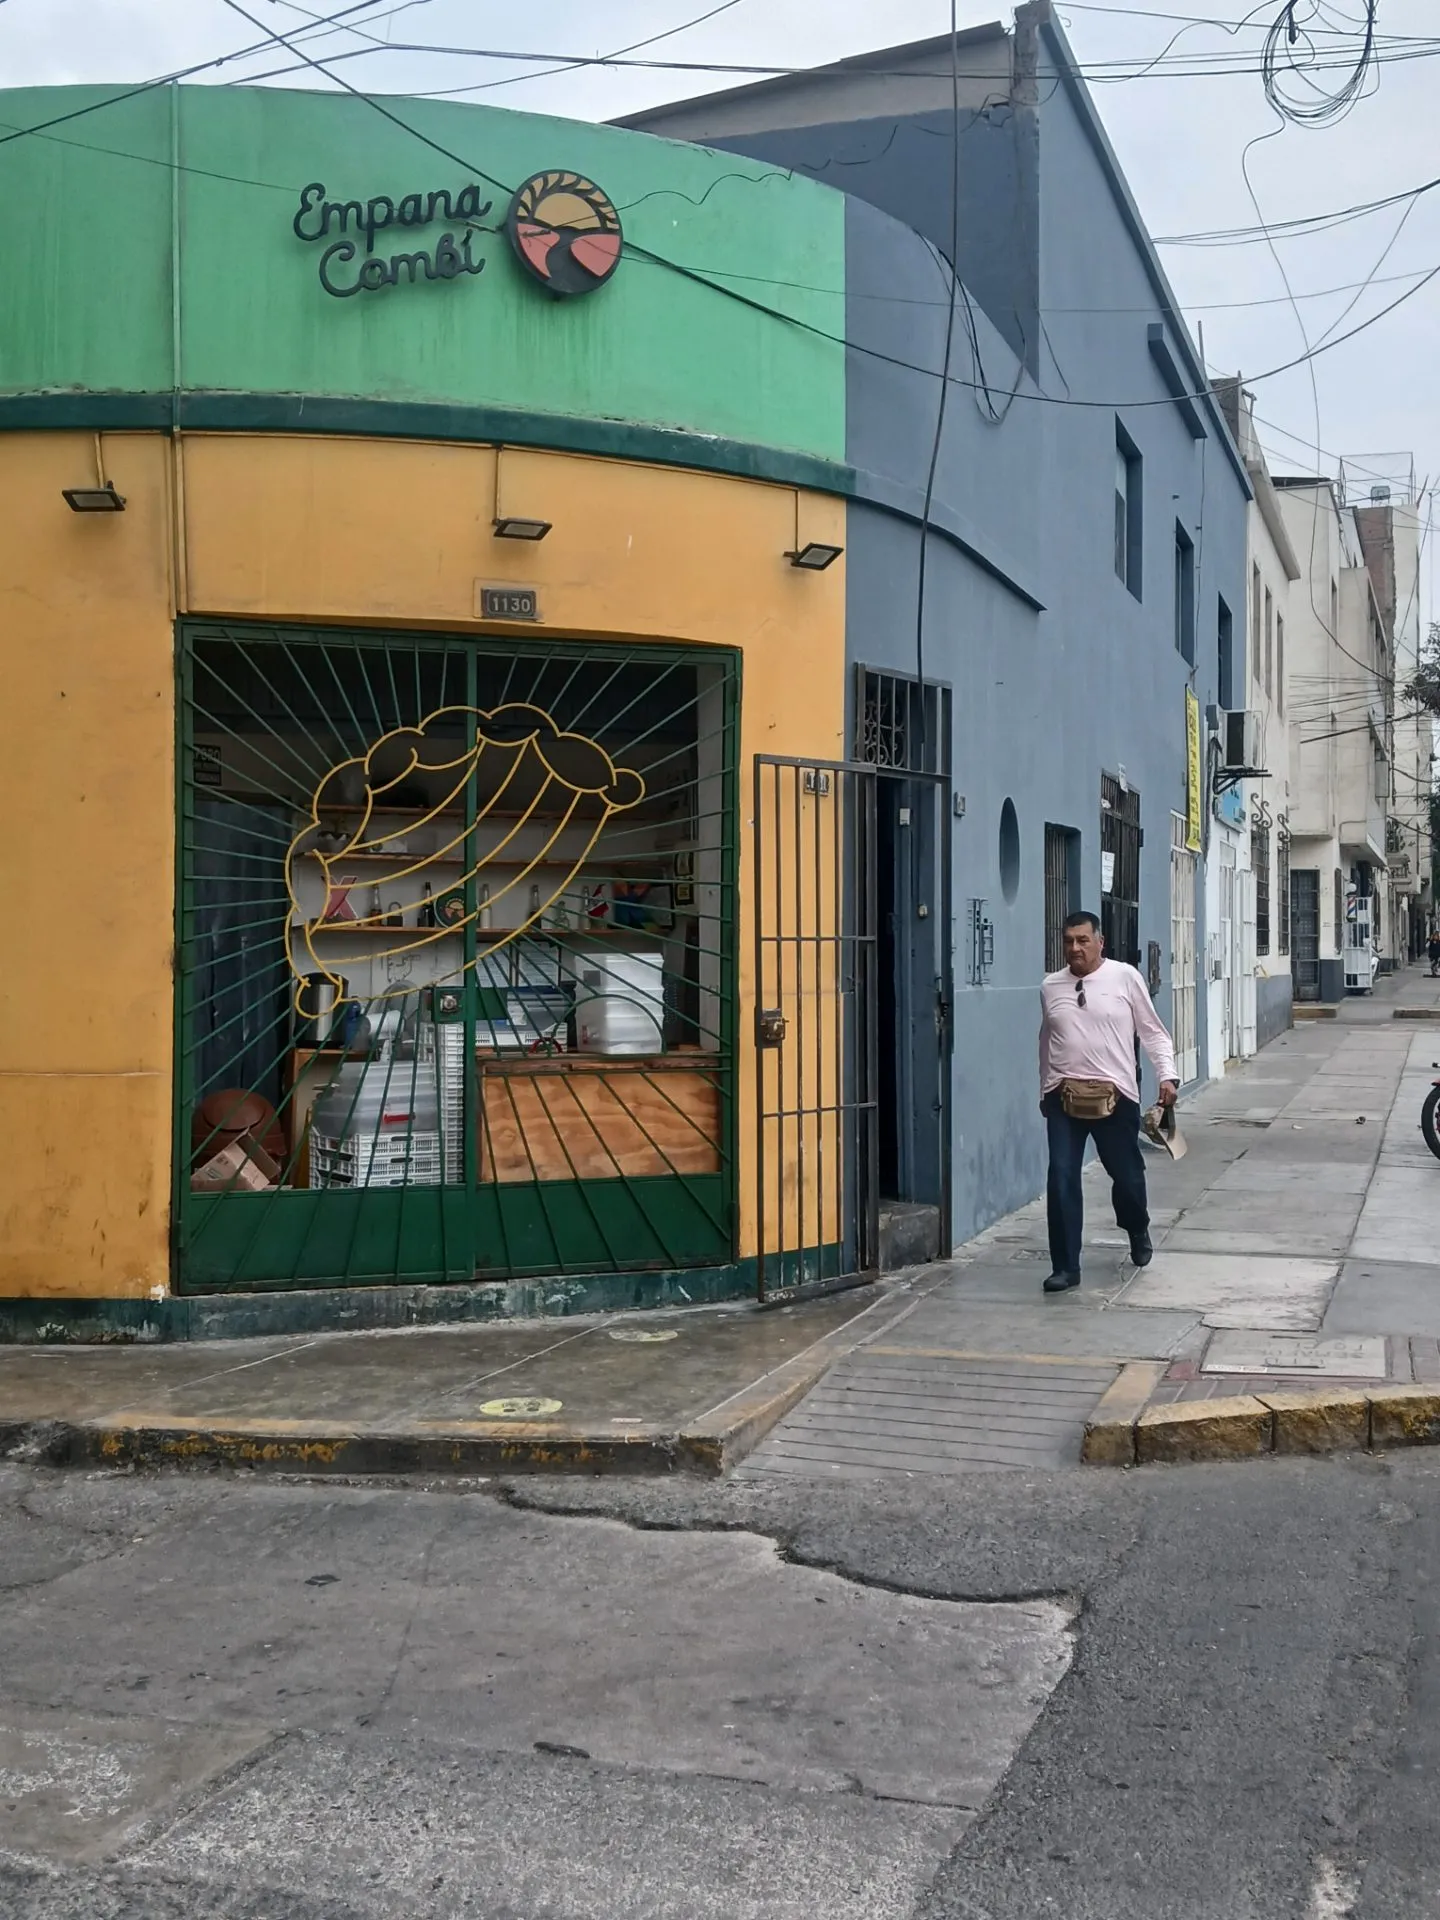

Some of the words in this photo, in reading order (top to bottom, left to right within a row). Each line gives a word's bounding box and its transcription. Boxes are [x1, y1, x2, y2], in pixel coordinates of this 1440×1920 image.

[294, 183, 493, 252] Empana
[319, 229, 486, 298] Combi
[493, 597, 531, 612] 1130
